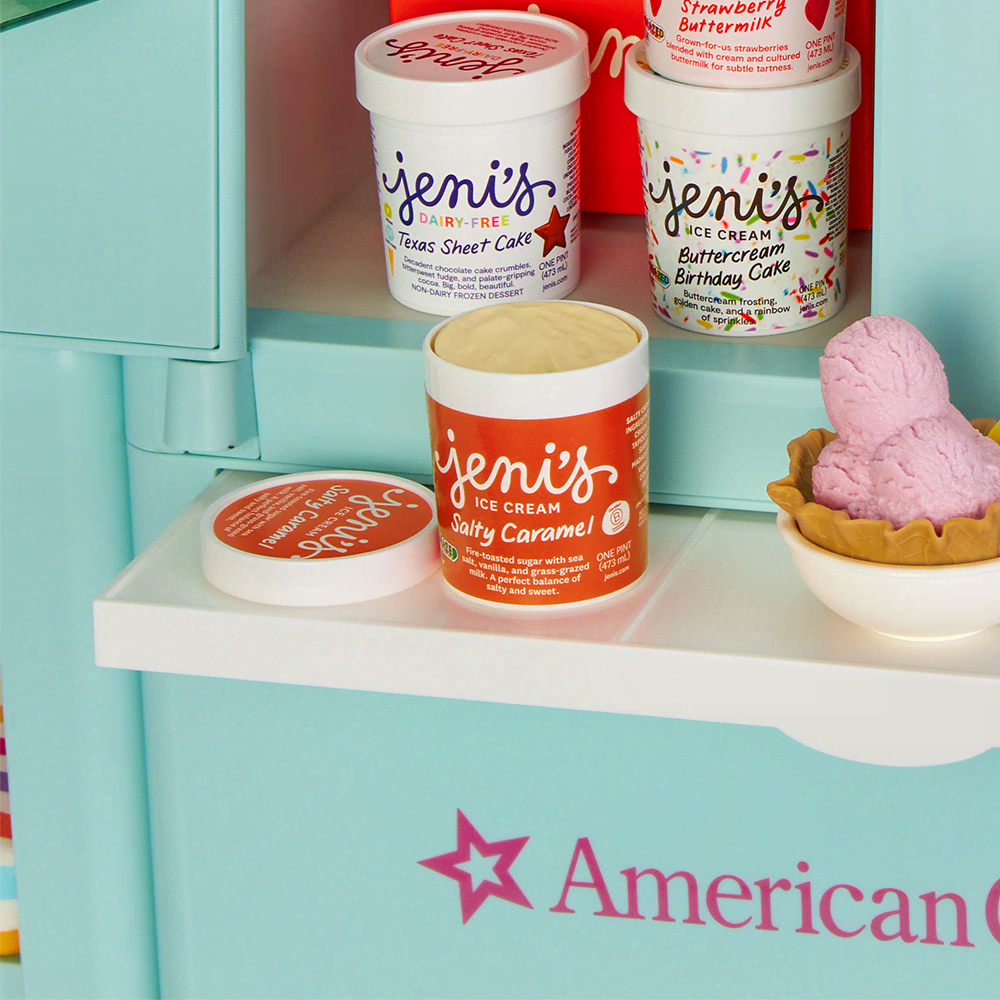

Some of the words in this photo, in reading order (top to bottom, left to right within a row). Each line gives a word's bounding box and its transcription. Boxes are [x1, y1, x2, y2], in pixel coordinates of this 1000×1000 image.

[679, 16, 772, 34] Buttermilk
[666, 41, 694, 56] blended
[696, 50, 714, 60] with
[716, 54, 744, 62] cream
[746, 53, 764, 62] and
[766, 51, 800, 62] cultured
[676, 34, 732, 52] Grown-for-us
[734, 43, 788, 52] strawberries
[806, 40, 822, 50] ONE
[671, 54, 709, 70] buttermilk
[711, 61, 724, 71] for
[726, 63, 754, 72] subtle
[756, 64, 794, 73] tartness.
[382, 151, 556, 226] jeni's
[648, 160, 824, 237] jeni's
[420, 212, 510, 229] DAIRY-FREE
[689, 224, 712, 239] ICE
[717, 230, 772, 240] CREAM
[398, 230, 436, 253] Texas
[440, 238, 491, 255] Sheet
[494, 231, 532, 252] Cake
[678, 243, 785, 264] Buttercream
[402, 263, 436, 280] bittersweet
[462, 274, 477, 283] and
[478, 268, 536, 282] palate-gripping
[403, 255, 434, 270] Decadent
[434, 264, 472, 274] chocolate
[474, 266, 494, 274] cake
[496, 262, 532, 274] crumbles,
[674, 267, 742, 290] Birthday
[748, 260, 790, 281] Cake
[412, 284, 451, 298] NON-DAIRY
[454, 291, 487, 300] FROZEN
[488, 288, 524, 300] DESSERT
[684, 289, 736, 306] Buttercream
[674, 296, 699, 310] golden
[726, 306, 744, 316] and
[754, 304, 790, 315] rainbow
[434, 428, 618, 509] jeni's
[475, 496, 498, 512] ICE
[504, 502, 561, 515] CREAM
[258, 510, 318, 550] Caramel
[290, 488, 418, 560] jeni's
[451, 512, 496, 547] Salty
[501, 515, 594, 544] Caramel
[466, 546, 514, 564] Fire-toasted
[517, 555, 544, 568] sugar
[544, 554, 566, 564] with
[568, 554, 584, 562] sea
[596, 550, 614, 562] ONE
[479, 561, 509, 576] vanilla,
[511, 566, 528, 576] and
[530, 562, 590, 578] grass-grazed
[598, 560, 617, 573] (473
[604, 565, 630, 582] jenis.com
[469, 568, 488, 580] milk.
[498, 575, 530, 586] perfect
[532, 575, 570, 586] balance
[571, 573, 582, 583] of
[486, 582, 508, 596] salty
[508, 586, 526, 596] and
[528, 587, 560, 596] sweet.
[549, 836, 976, 948] American
